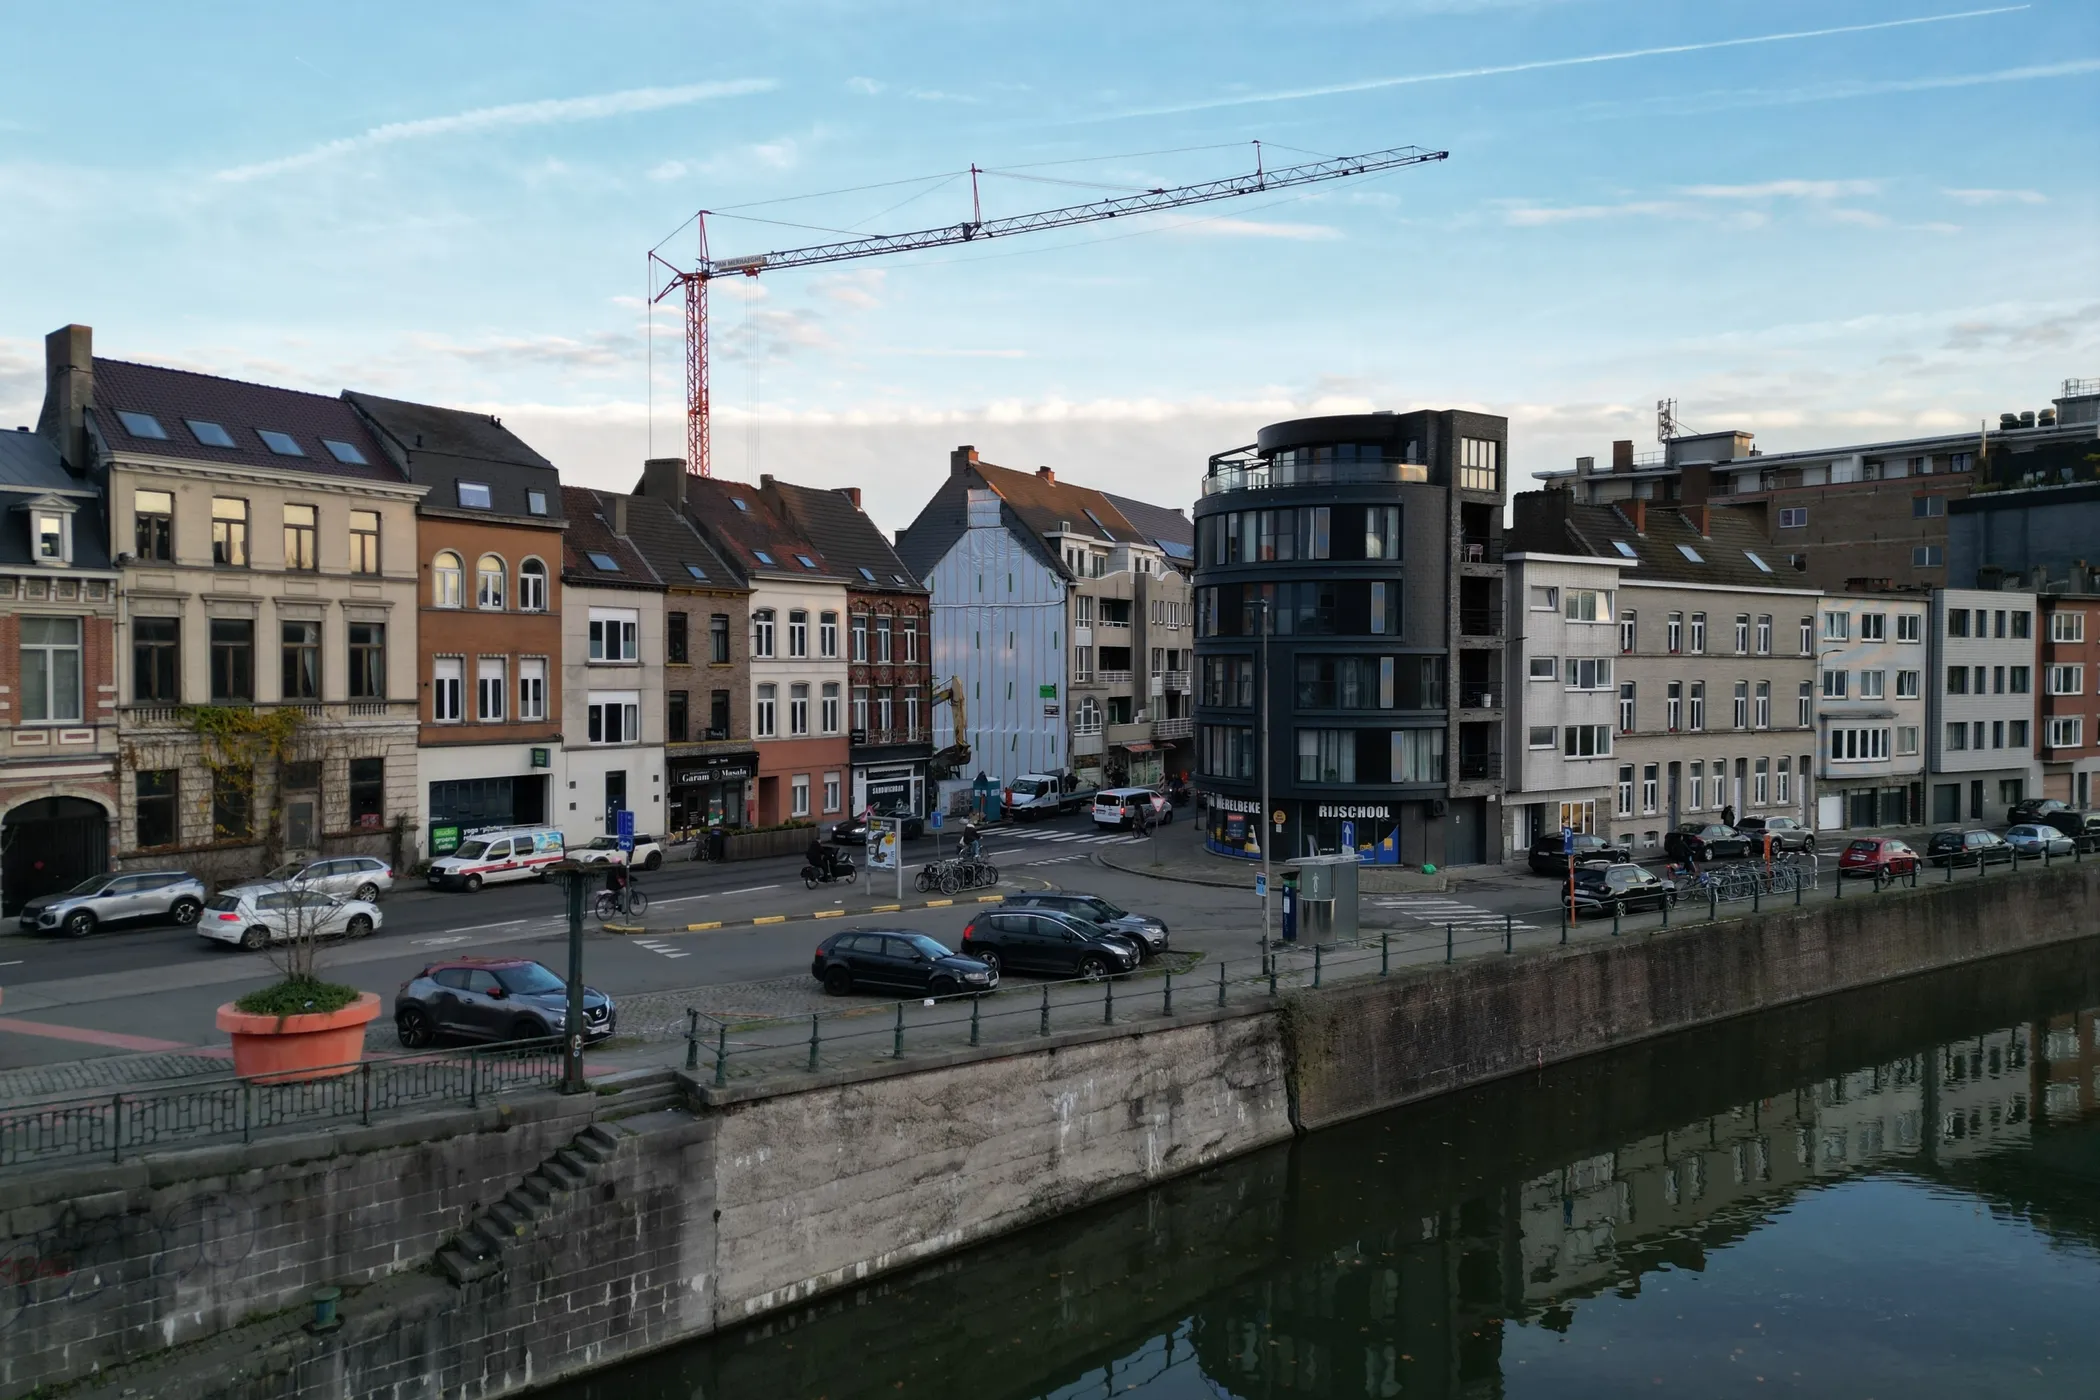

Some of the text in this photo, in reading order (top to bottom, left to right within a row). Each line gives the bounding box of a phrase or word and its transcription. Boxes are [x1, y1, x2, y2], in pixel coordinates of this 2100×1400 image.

[715, 260, 727, 268] VAN
[682, 768, 747, 782] Garam Masala
[1318, 805, 1391, 818] RIJSCHOOL
[435, 828, 456, 836] studio
[1564, 828, 1572, 843] P
[434, 836, 456, 844] groene
